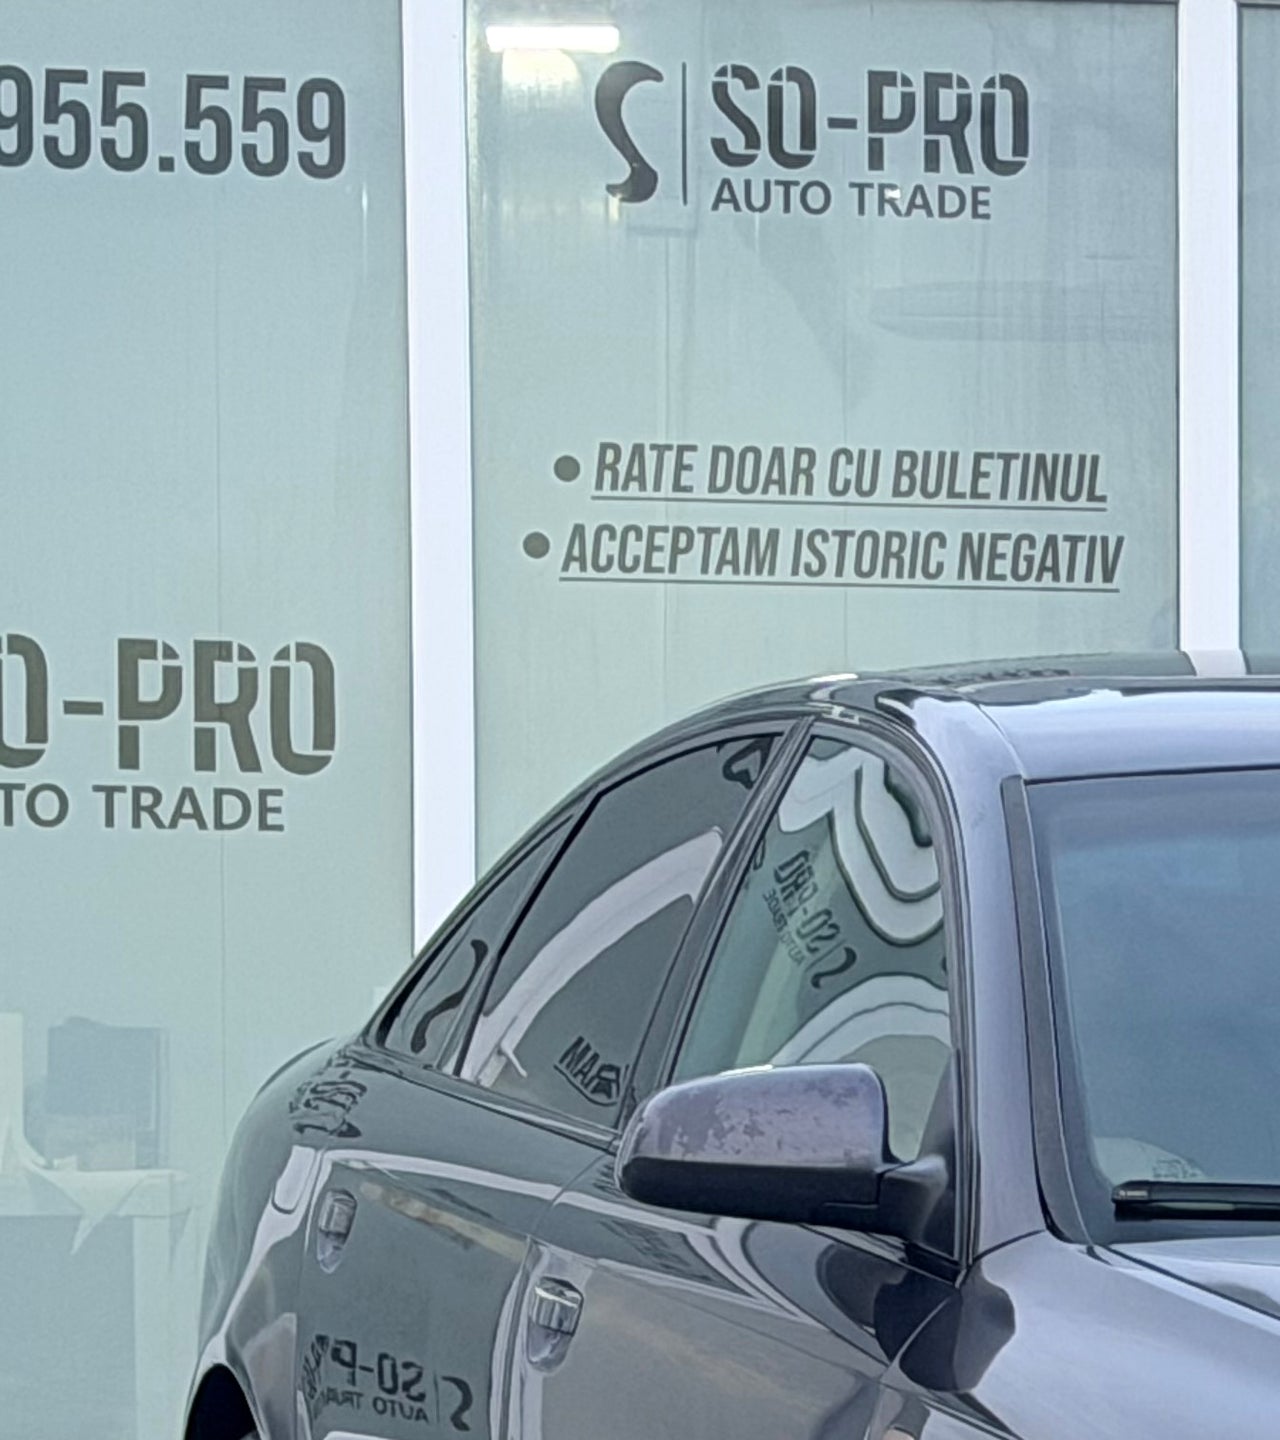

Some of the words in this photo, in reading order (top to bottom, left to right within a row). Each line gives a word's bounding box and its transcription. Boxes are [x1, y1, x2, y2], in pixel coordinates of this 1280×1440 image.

[710, 64, 1030, 177] SO-PRO
[711, 178, 832, 215] AUTO
[848, 181, 991, 220] TRADE
[594, 441, 699, 494] RATE
[707, 444, 817, 497] DOAR
[828, 447, 882, 498] CU
[891, 450, 1108, 503] BULETINUL
[561, 523, 780, 577] ACCEPTAM
[790, 528, 947, 581] ISTORIC
[957, 532, 1125, 584] NEGATIV
[91, 784, 285, 832] TRADE
